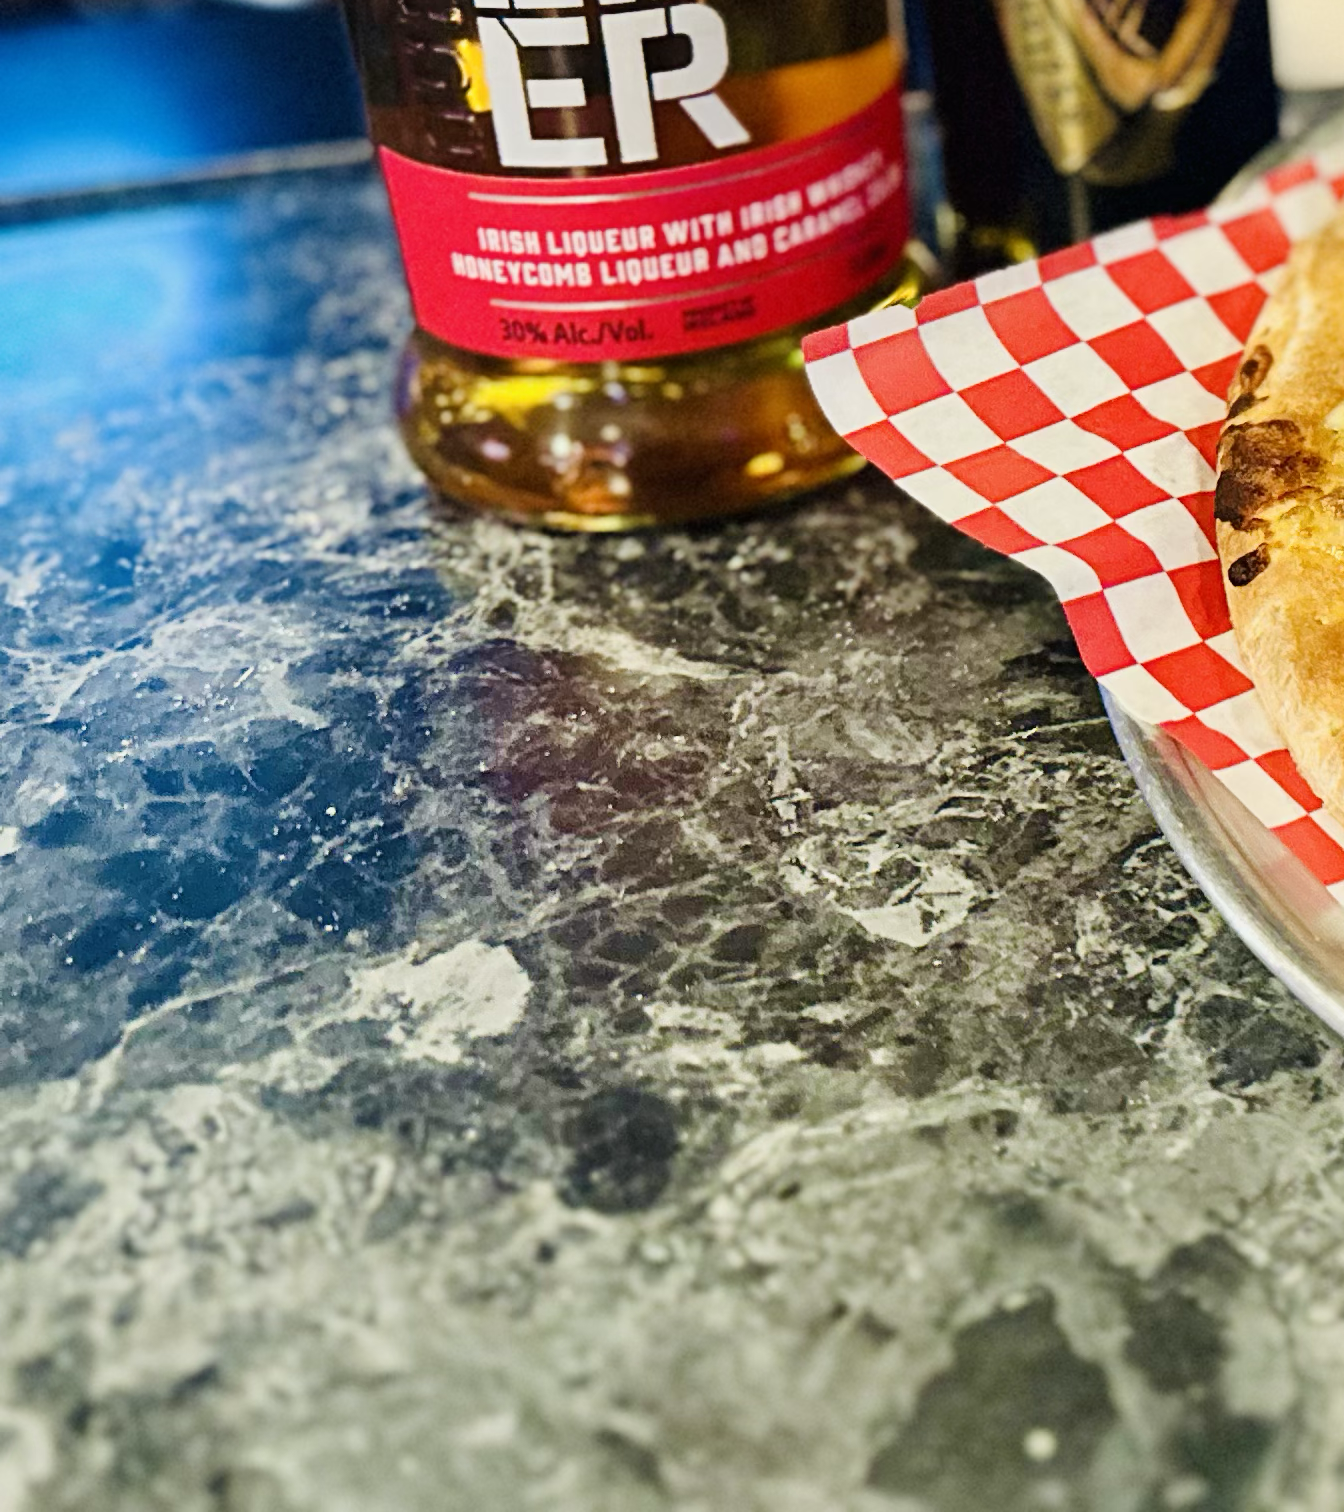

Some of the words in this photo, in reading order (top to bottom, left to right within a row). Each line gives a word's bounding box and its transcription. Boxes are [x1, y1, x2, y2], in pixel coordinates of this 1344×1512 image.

[477, 2, 752, 167] ER
[450, 251, 593, 288] HONEYCOMB
[598, 246, 710, 286] LIQUEUR
[717, 232, 768, 269] AND
[477, 226, 541, 255] IRISH
[546, 224, 656, 258] LIQUEUR
[662, 210, 734, 247] WITH
[500, 317, 548, 342] 30%
